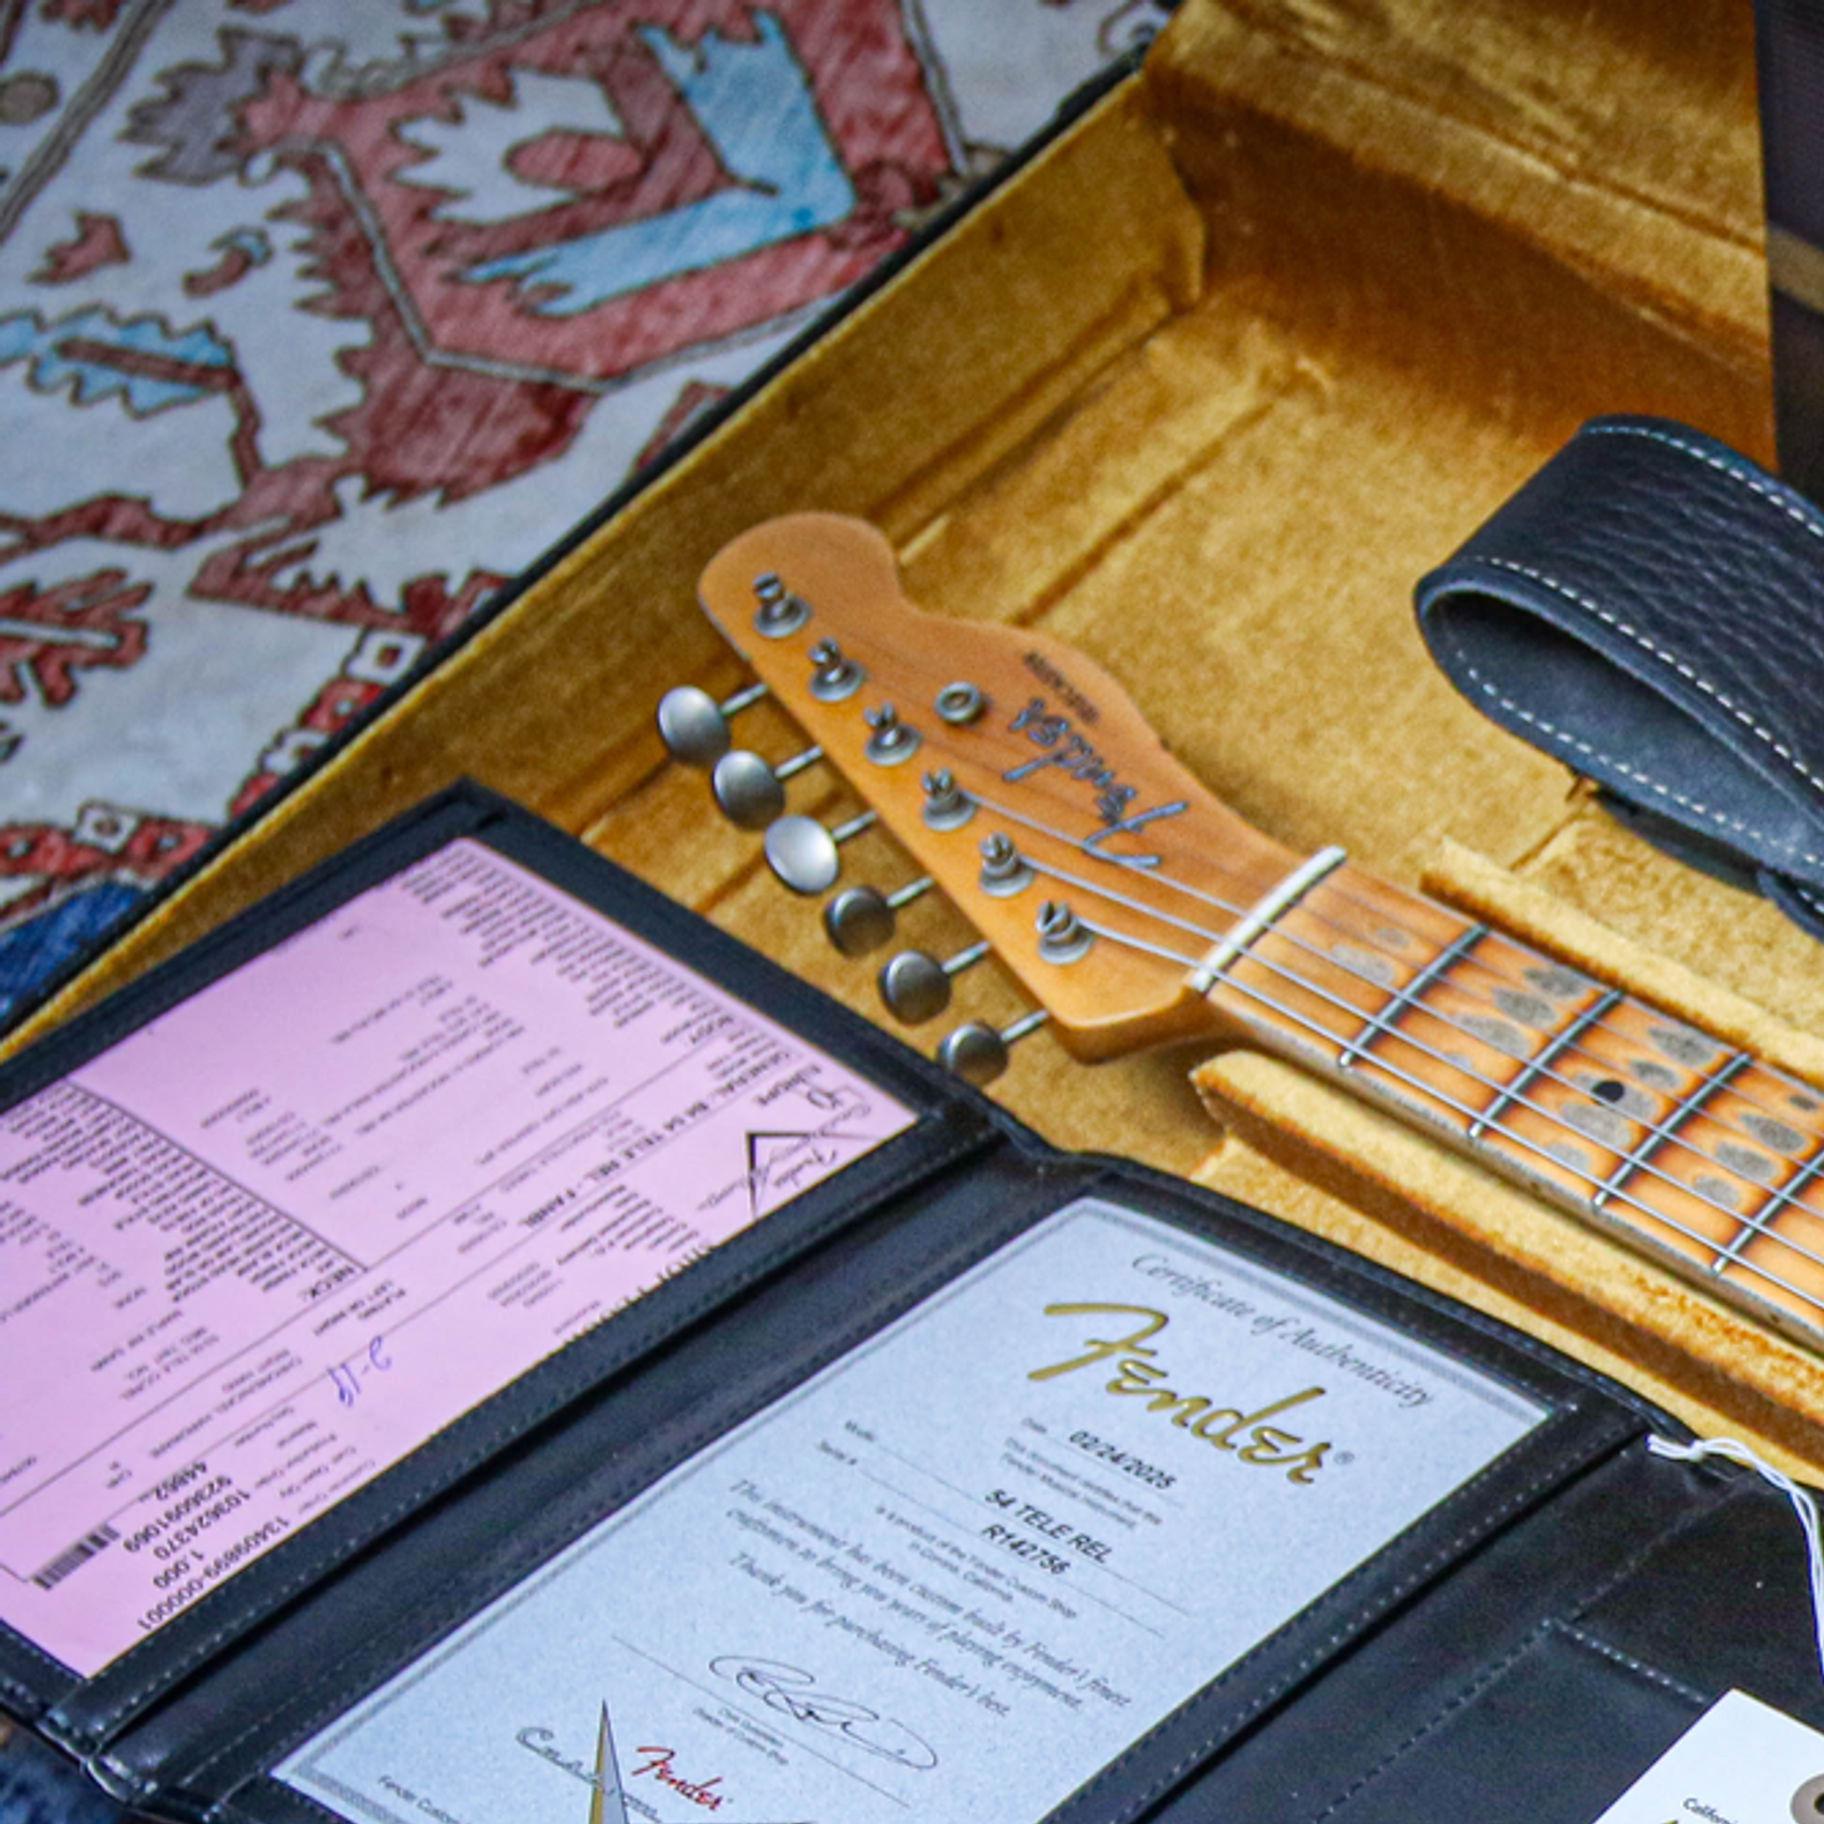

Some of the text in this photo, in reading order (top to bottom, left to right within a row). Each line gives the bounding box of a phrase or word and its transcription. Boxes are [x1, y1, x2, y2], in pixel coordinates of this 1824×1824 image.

[1117, 1248, 1441, 1414] Certificate of Authenticity
[1026, 1301, 1316, 1486] Fender
[1064, 1428, 1179, 1492] 02/24/2025
[758, 1497, 851, 1551] instrument
[868, 1557, 918, 1587] been
[904, 1581, 966, 1616] custom
[981, 1487, 1019, 1511] 54
[1010, 1502, 1076, 1542] TELE
[1063, 1531, 1118, 1565] REL
[635, 1745, 725, 1812] Fender
